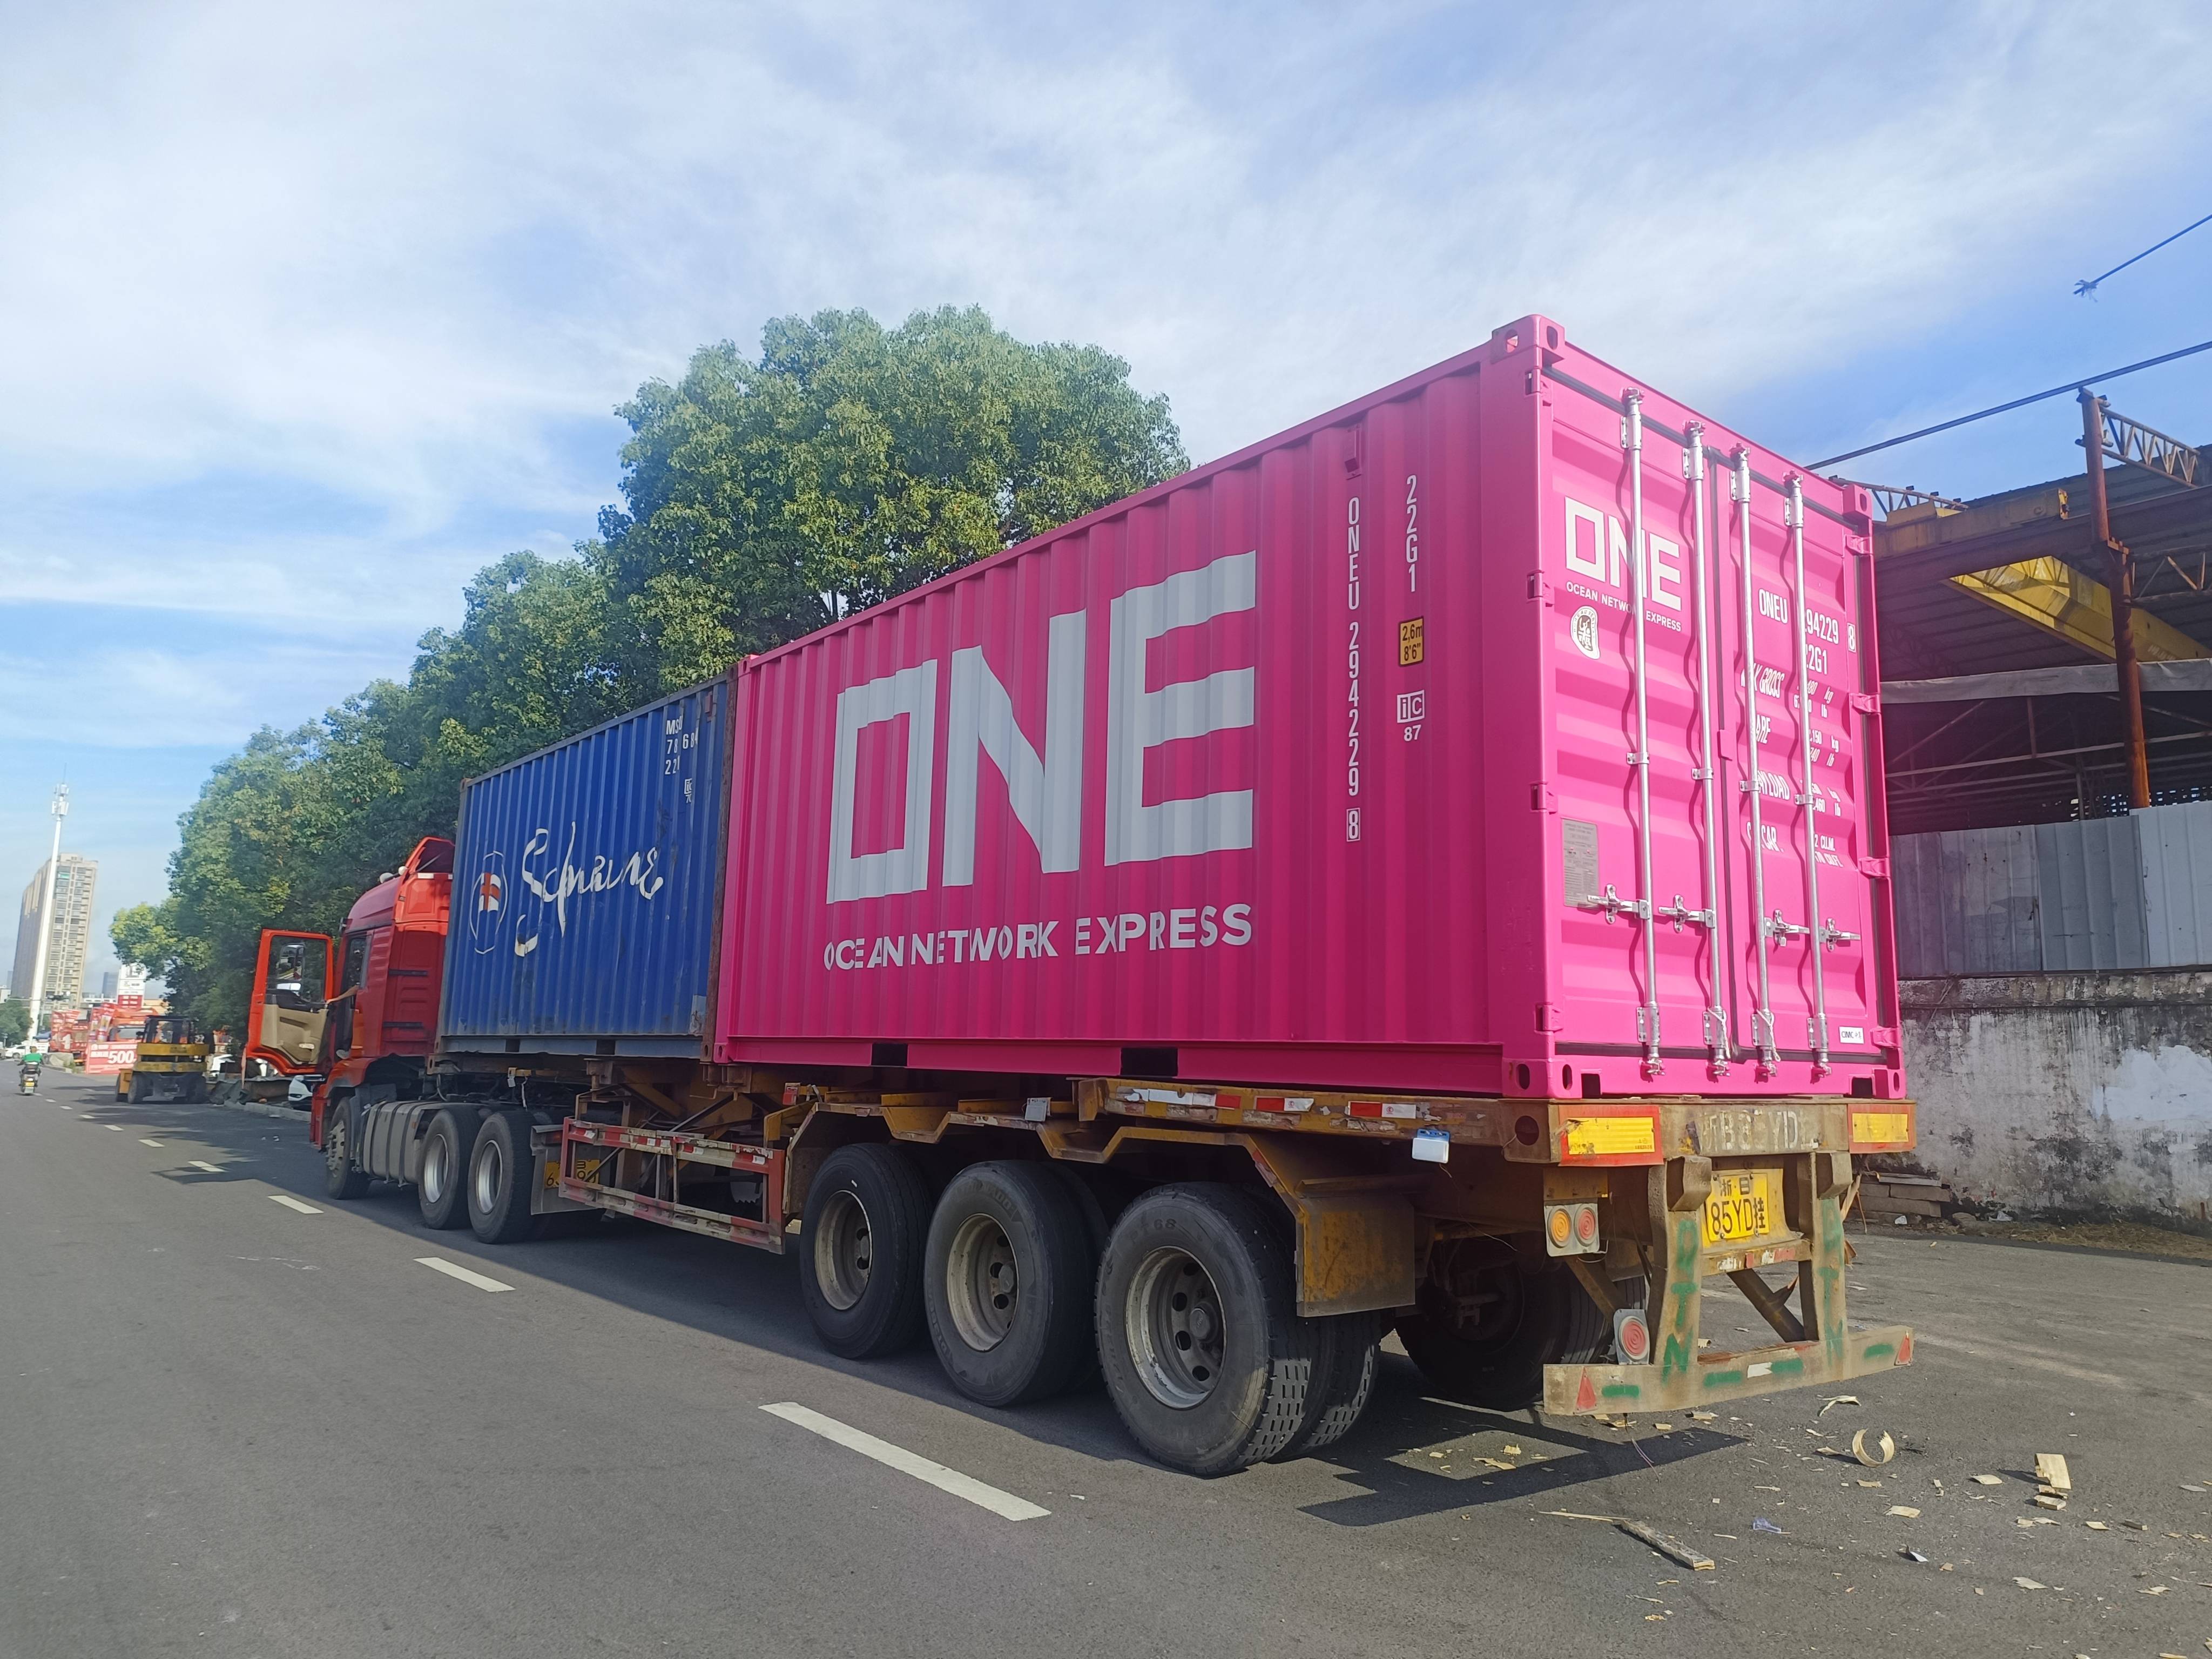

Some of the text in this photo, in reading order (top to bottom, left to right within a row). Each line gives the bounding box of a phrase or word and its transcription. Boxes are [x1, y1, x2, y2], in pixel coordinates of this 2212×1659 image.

[1406, 475, 1418, 592] 22G1
[1566, 496, 1681, 611] ONE
[1566, 581, 1681, 632] OCEAN NETWO EXPRESS
[1759, 589, 1855, 651] ONEU 94229 8
[1347, 497, 1359, 840] ONEU 294229 8
[1806, 644, 1827, 675] 2G1
[826, 550, 1256, 904] ONE
[1404, 725, 1421, 741] 87
[1756, 714, 1771, 744] ARE
[1822, 704, 1827, 718] lb
[1757, 770, 1790, 800] AYLOAD
[824, 903, 1252, 969] OCEAN NETWORK EXPRESS
[108, 1051, 135, 1064] 500
